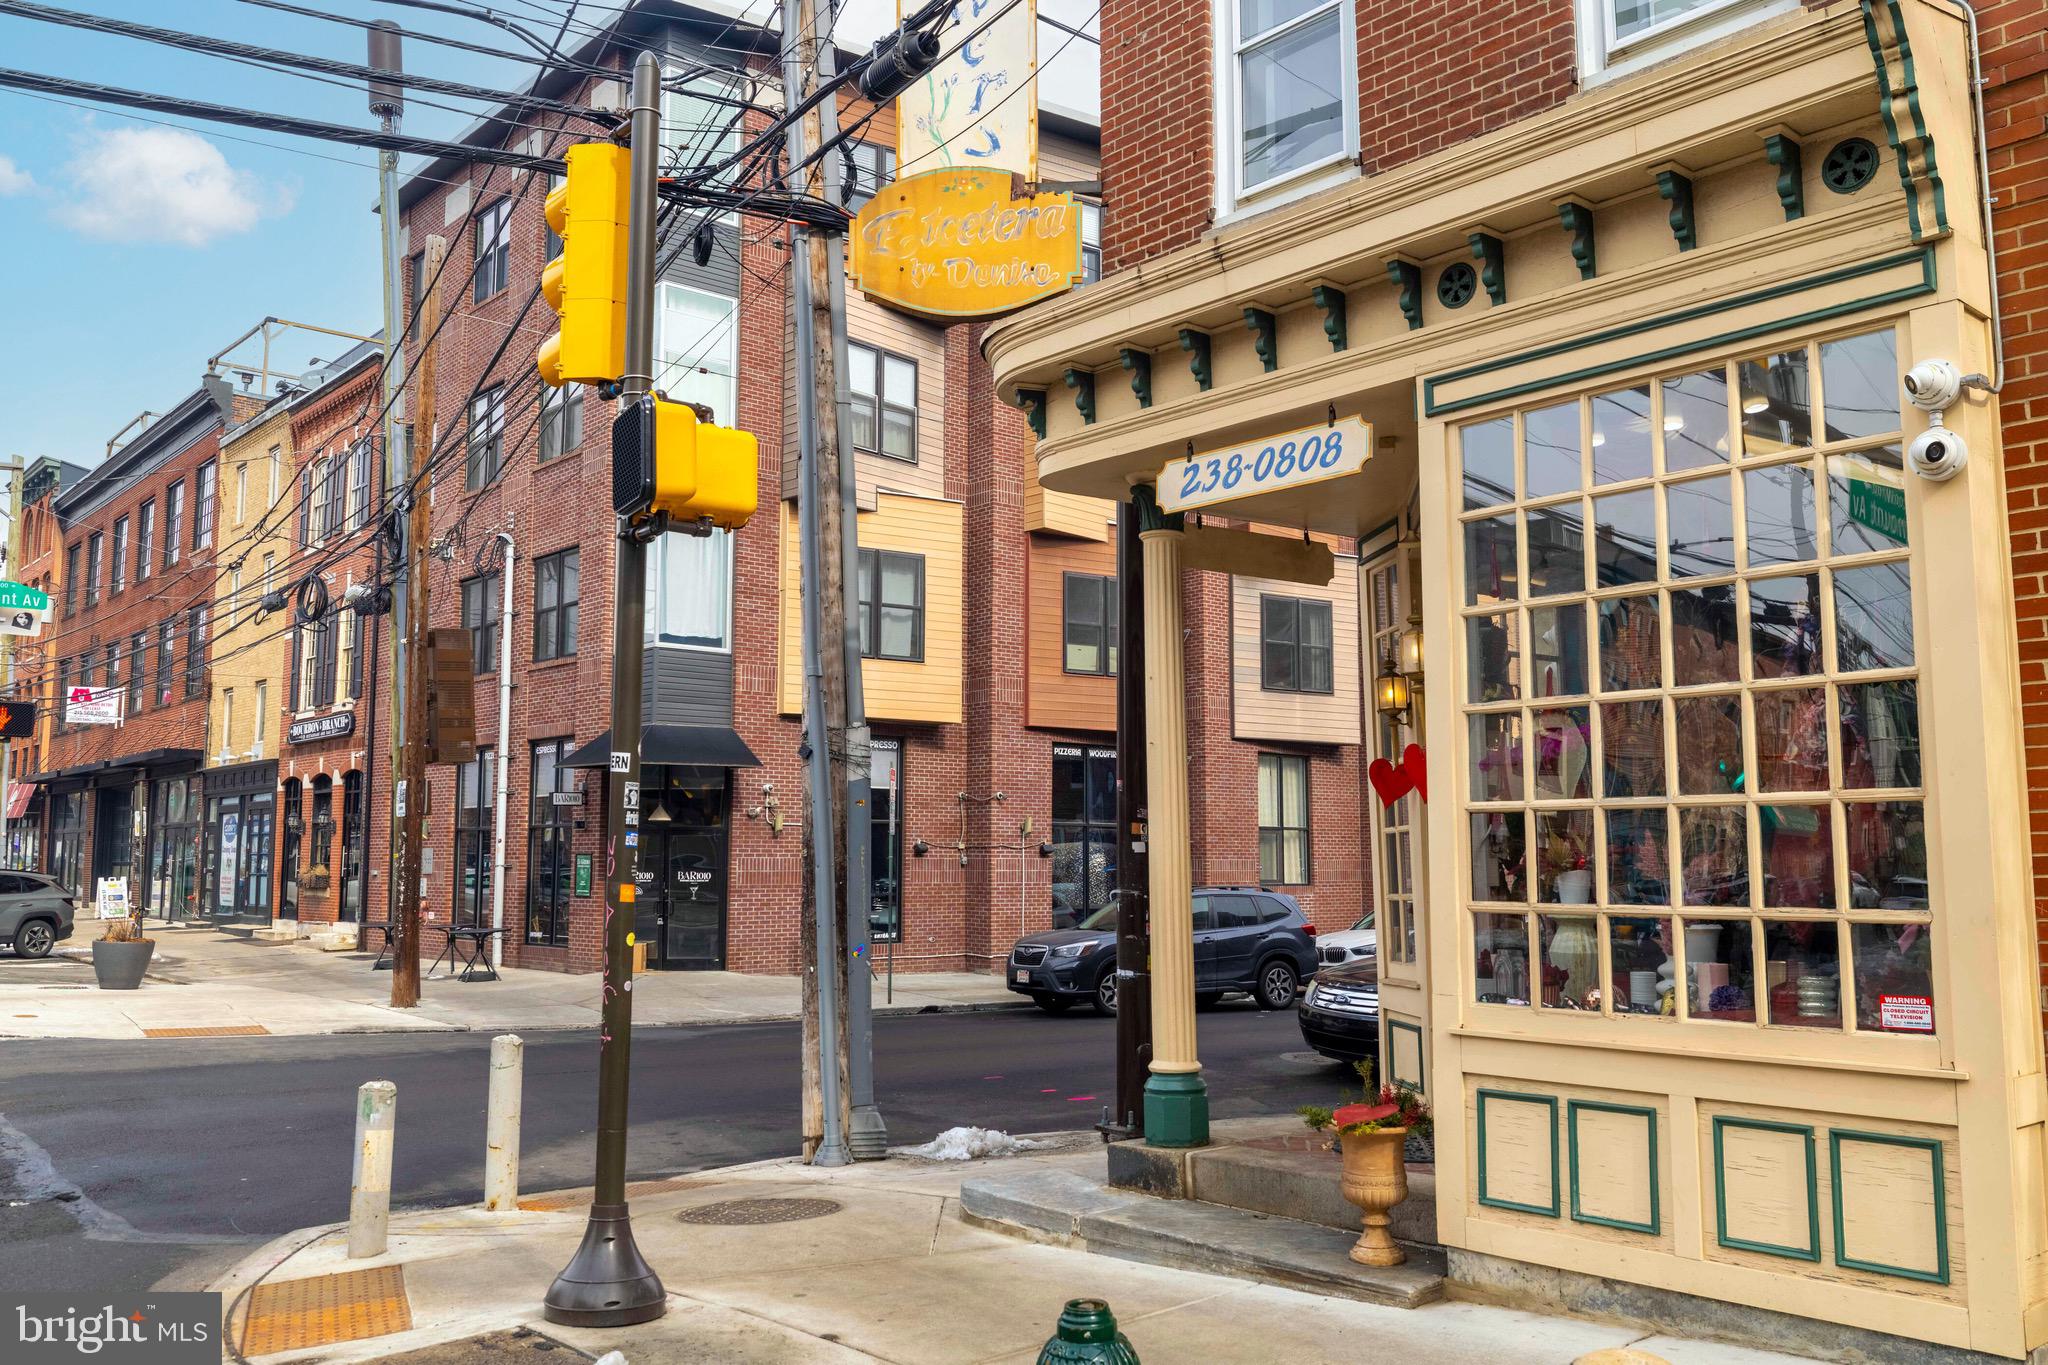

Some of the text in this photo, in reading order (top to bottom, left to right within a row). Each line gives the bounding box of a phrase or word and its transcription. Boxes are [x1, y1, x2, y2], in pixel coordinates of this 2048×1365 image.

[1180, 431, 1343, 499] 238-0808
[23, 594, 40, 606] Av
[1054, 747, 1082, 757] PIZZERIA
[677, 871, 712, 880] BAR1010
[1884, 997, 1926, 1005] WARNING
